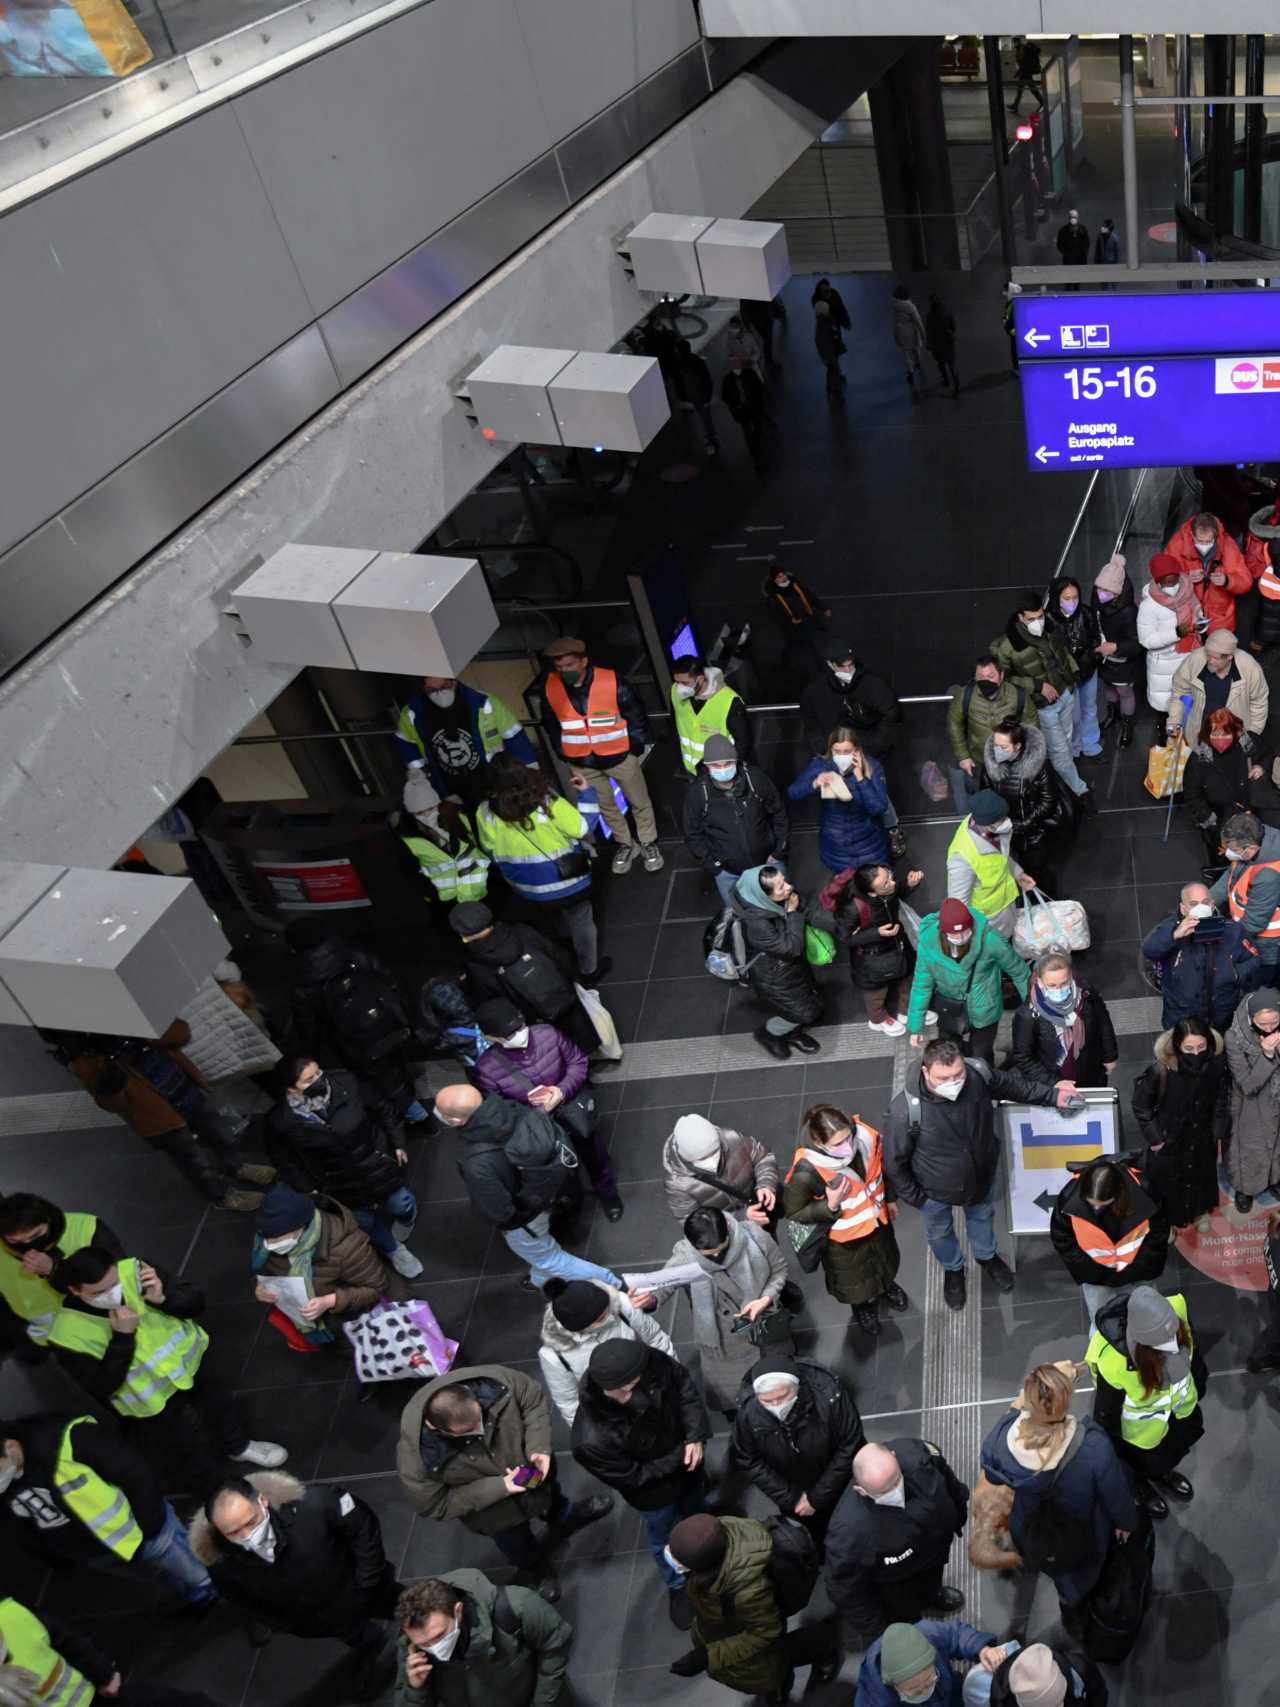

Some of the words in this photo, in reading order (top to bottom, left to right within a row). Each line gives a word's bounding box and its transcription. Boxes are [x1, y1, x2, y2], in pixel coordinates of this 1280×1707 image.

[1063, 365, 1157, 400] 15-16
[1232, 370, 1258, 382] BUS
[1068, 422, 1118, 436] Ausgang
[1068, 435, 1135, 449] Europaplatz
